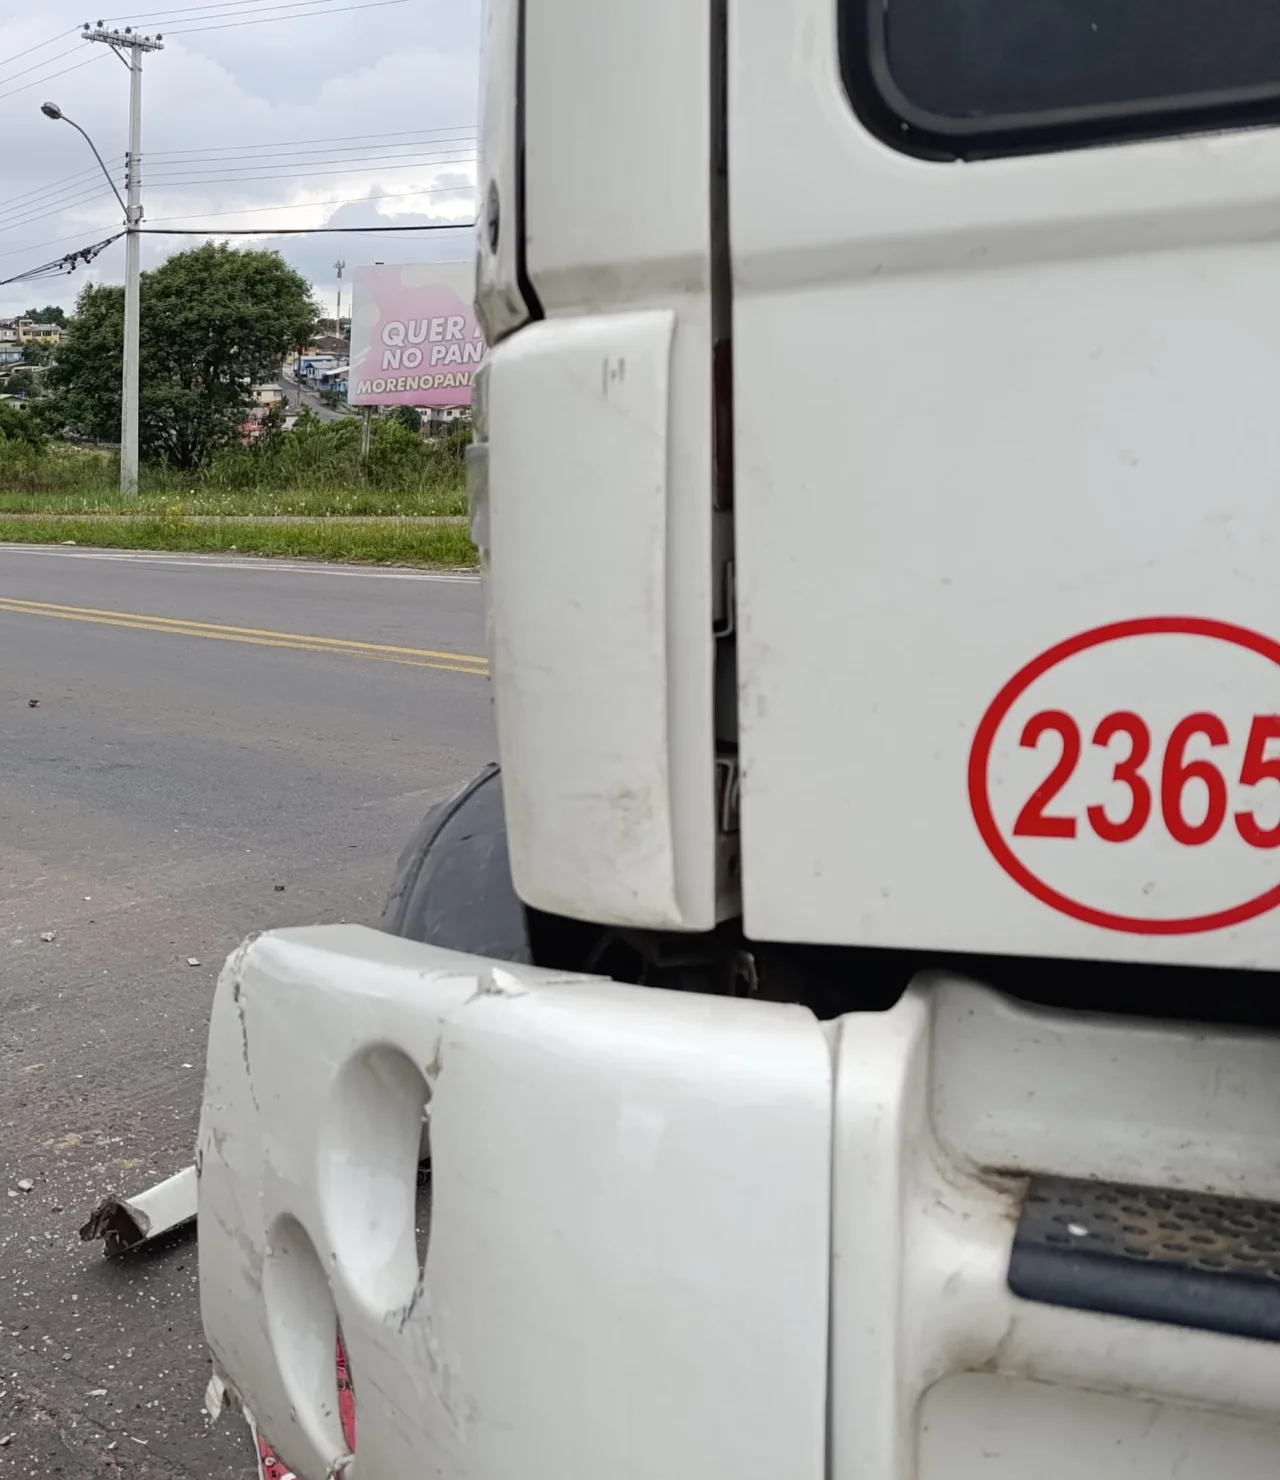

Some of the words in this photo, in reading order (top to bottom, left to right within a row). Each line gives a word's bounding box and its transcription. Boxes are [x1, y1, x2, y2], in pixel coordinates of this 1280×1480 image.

[382, 316, 465, 347] QUER
[381, 347, 423, 371] NO
[432, 342, 486, 367] PAN
[357, 373, 475, 395] MORENOPAN
[1012, 709, 1280, 850] 2365
